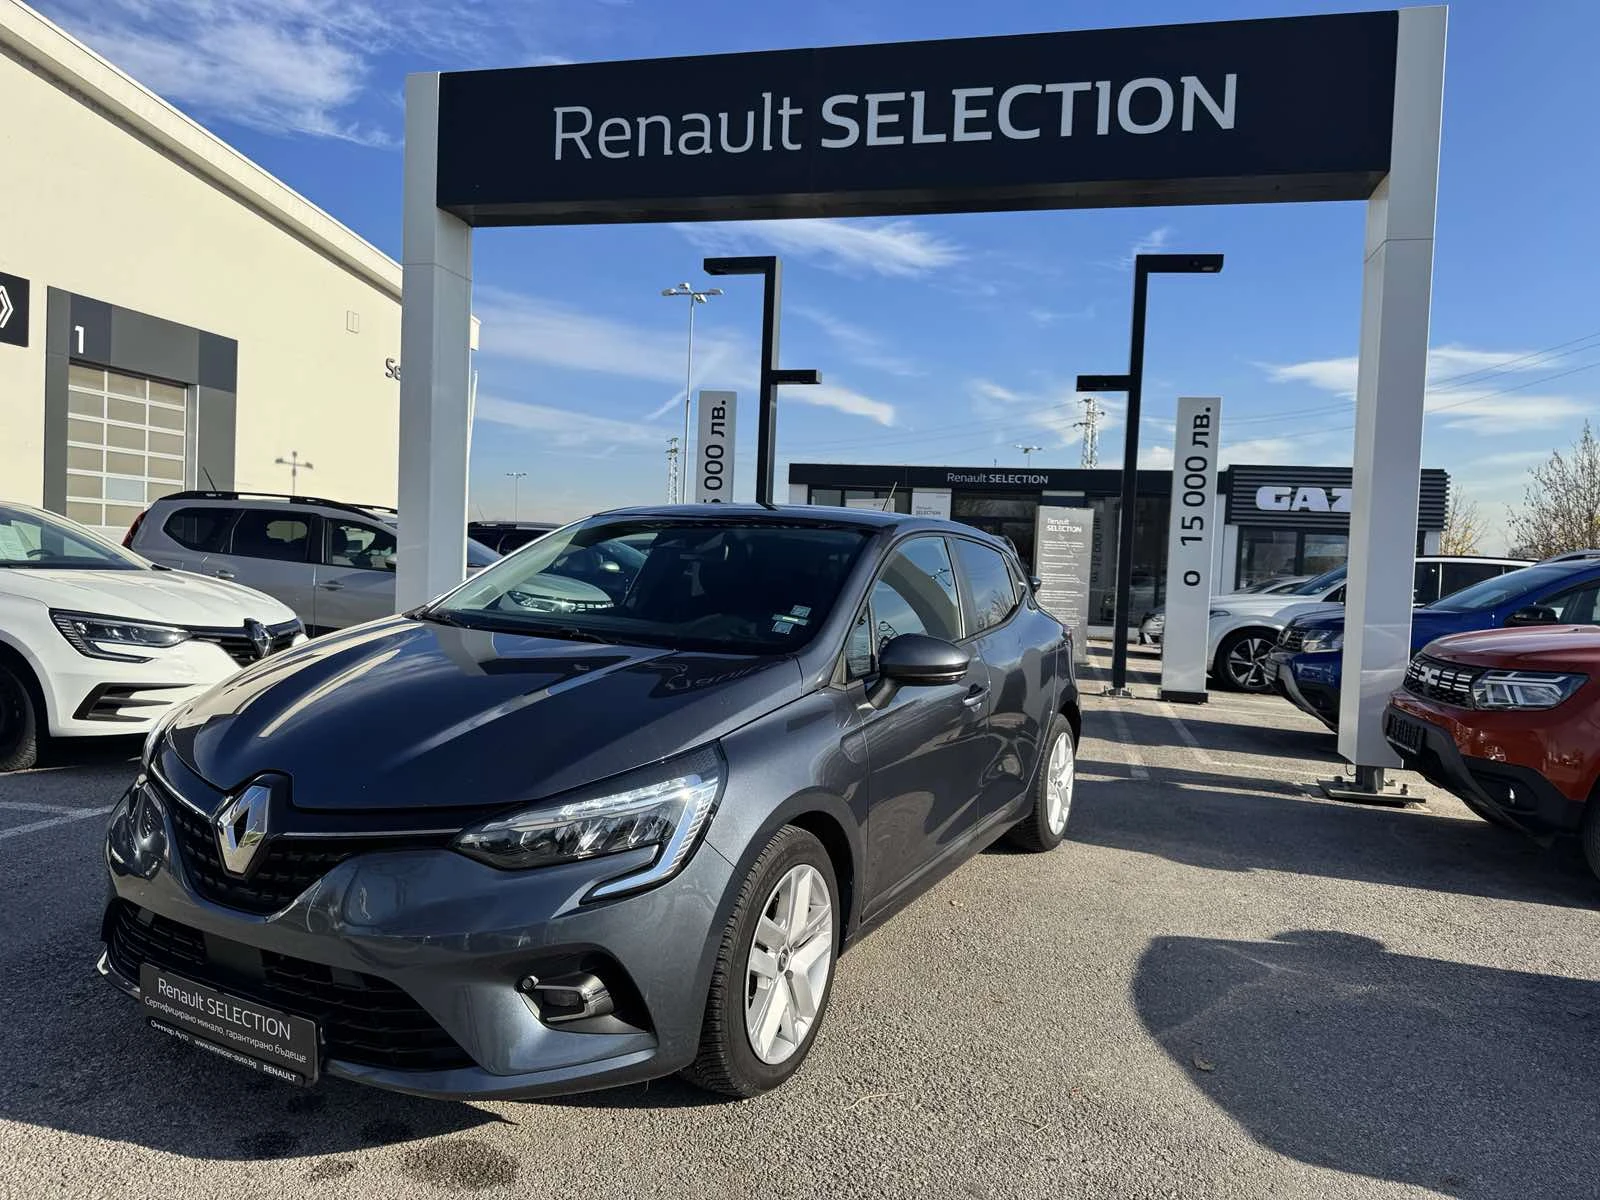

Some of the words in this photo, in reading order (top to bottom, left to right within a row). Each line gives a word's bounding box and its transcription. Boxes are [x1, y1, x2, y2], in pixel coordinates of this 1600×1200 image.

[552, 91, 803, 161] Renault
[820, 73, 1238, 149] SELECTION
[74, 325, 84, 354] 1
[711, 400, 726, 438] лв.
[1192, 407, 1211, 448] лв.
[703, 444, 724, 491] 000
[947, 472, 988, 483] Renault
[988, 474, 1049, 484] SELECTION
[1182, 456, 1208, 507] 000
[1046, 525, 1082, 533] SELECTION
[1180, 516, 1204, 546] 15
[158, 977, 204, 1012] Renault
[207, 998, 291, 1041] SELECTION
[144, 996, 197, 1024] Сертифицирано
[225, 1029, 274, 1052] гарантирано
[274, 1044, 307, 1064] бъдеще
[263, 1064, 297, 1082] RENAULT
